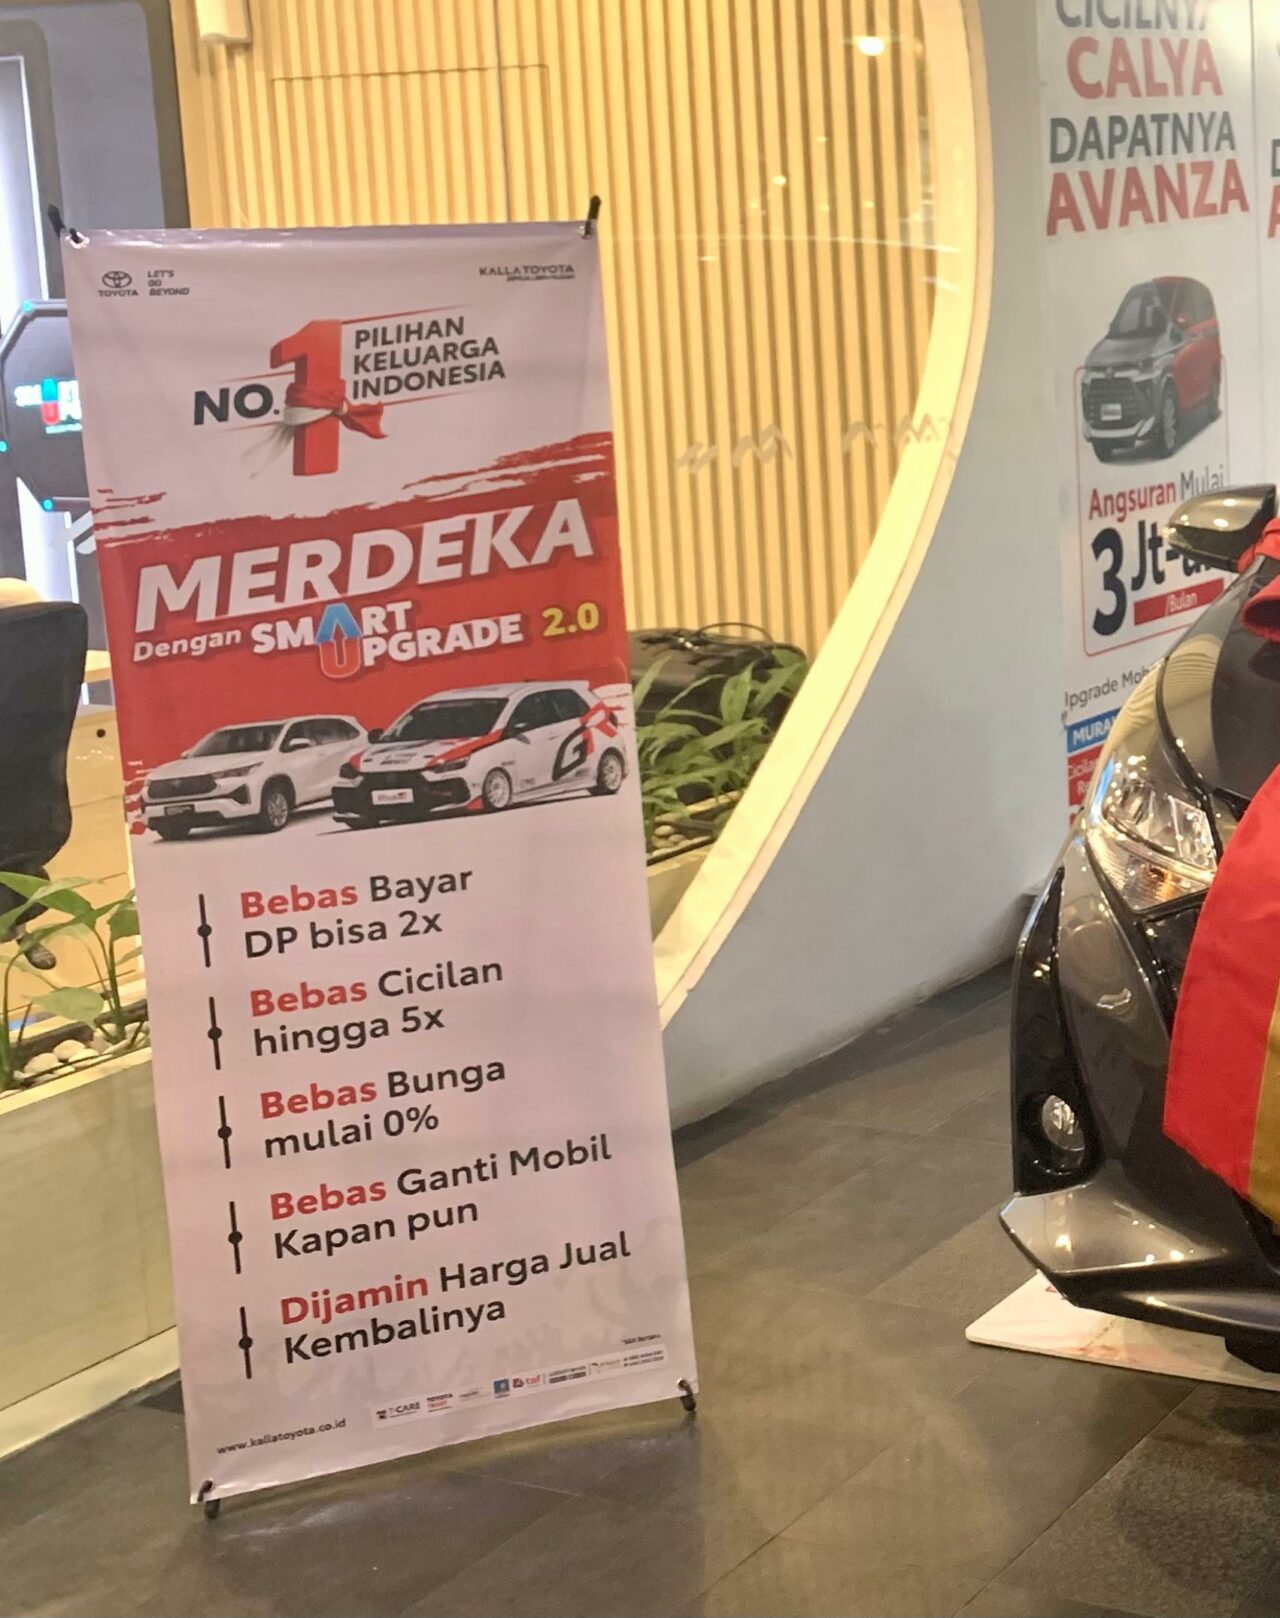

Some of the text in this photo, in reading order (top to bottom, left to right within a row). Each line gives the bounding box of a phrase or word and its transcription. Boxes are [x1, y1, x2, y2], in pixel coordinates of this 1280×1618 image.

[1055, 0, 1208, 31] CICILNY
[1066, 35, 1224, 100] CALYA
[1049, 111, 1237, 164] DAPATNYA
[1046, 158, 1250, 237] AVANZA
[98, 289, 138, 297] TOYOTA
[149, 287, 190, 296] BEYOND
[353, 337, 500, 375] KELUARGA
[354, 316, 466, 350] PILIHAN
[193, 383, 281, 427] NO.
[352, 360, 506, 400] INDONESIA
[1089, 463, 1224, 523] Angsuran Mulai
[133, 498, 595, 634] MERDEKA
[1091, 526, 1128, 636] 3
[133, 628, 242, 662] Dengan
[542, 601, 601, 638] 2.0
[1122, 666, 1151, 687] Mob
[240, 869, 474, 919] Bebas Bayar
[244, 910, 443, 959] DP bisa 2x
[249, 961, 504, 1017] Bebas Cicilan
[253, 1005, 446, 1057] hingga 5x
[259, 1060, 507, 1119] Bebas Bunga
[264, 1104, 440, 1158] mulai 0%
[269, 1133, 613, 1221] Bebas Ganti Mobil
[273, 1201, 479, 1259] Kapan pun
[280, 1230, 632, 1325] Dijamin Harga Jual
[284, 1299, 506, 1364] Kembalinya
[216, 1417, 347, 1455] www.kallatoyota.co.id
